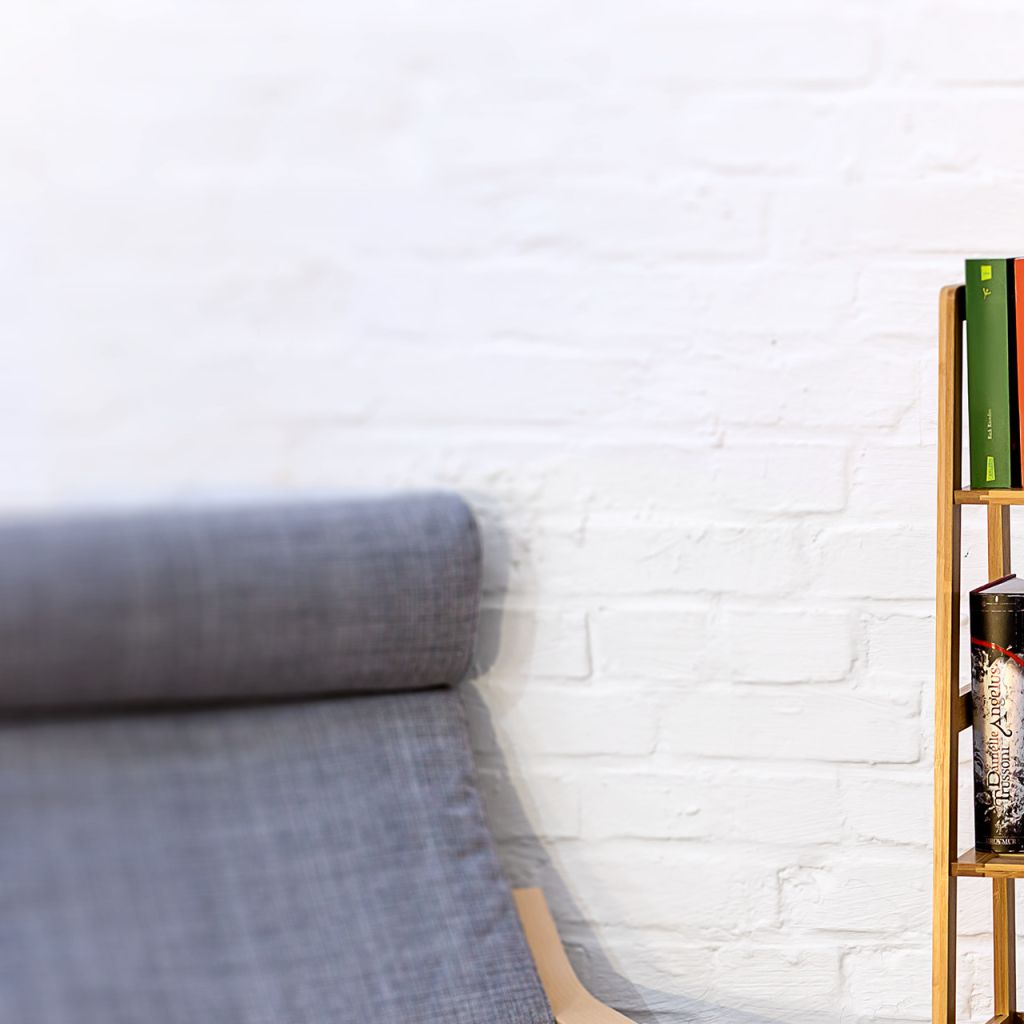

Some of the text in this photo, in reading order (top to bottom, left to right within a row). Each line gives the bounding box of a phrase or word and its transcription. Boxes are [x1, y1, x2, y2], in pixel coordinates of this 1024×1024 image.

[988, 667, 1012, 738] Angelus
[987, 731, 1000, 788] Danielle
[994, 746, 1010, 806] Trussoni
